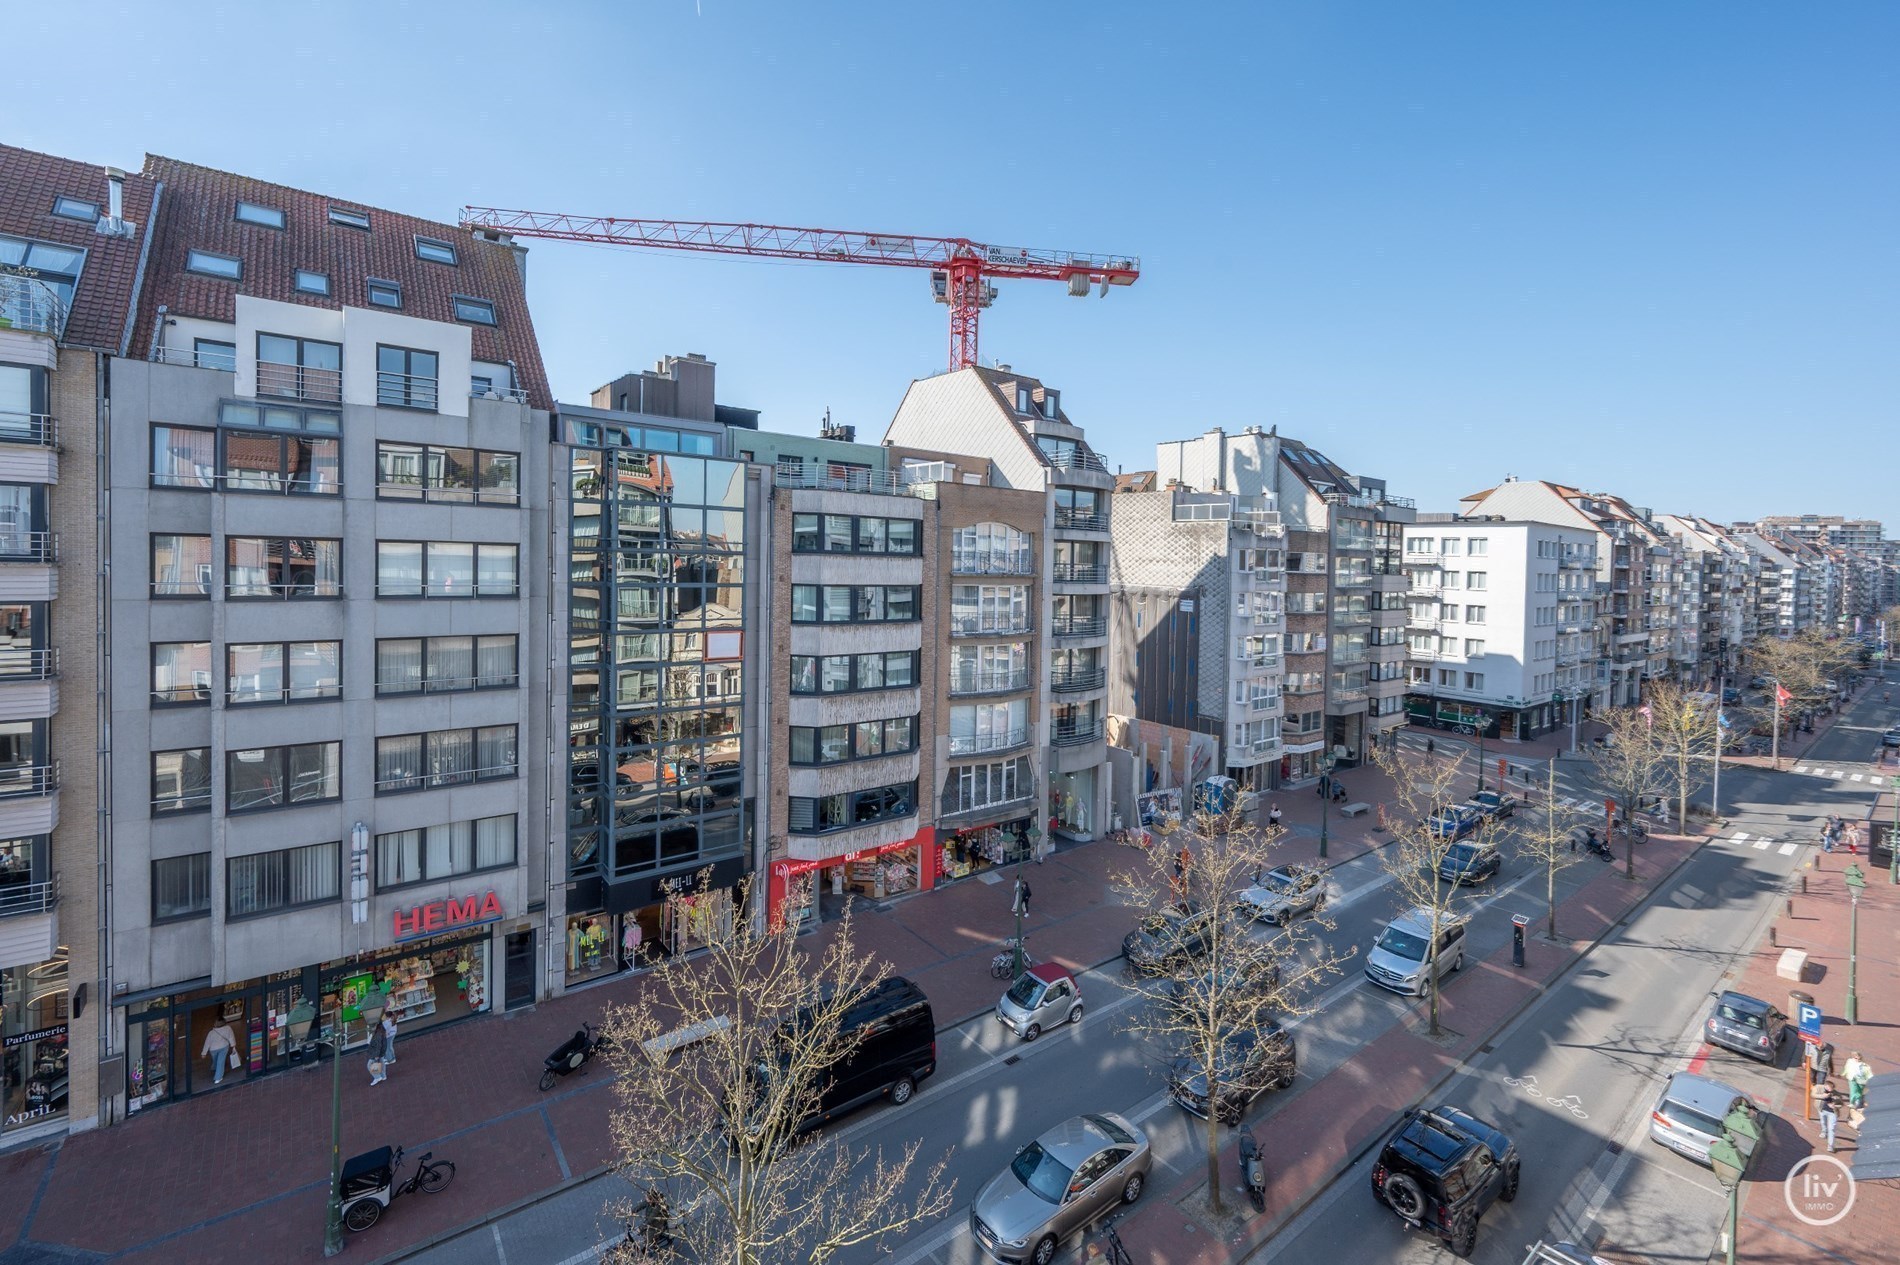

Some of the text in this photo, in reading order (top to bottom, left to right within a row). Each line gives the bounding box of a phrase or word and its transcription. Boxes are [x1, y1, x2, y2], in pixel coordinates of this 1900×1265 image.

[988, 256, 1028, 264] KERSCHAEVER
[394, 890, 503, 937] HEMA
[1801, 1006, 1818, 1023] P
[6, 1026, 66, 1045] Parfumerie
